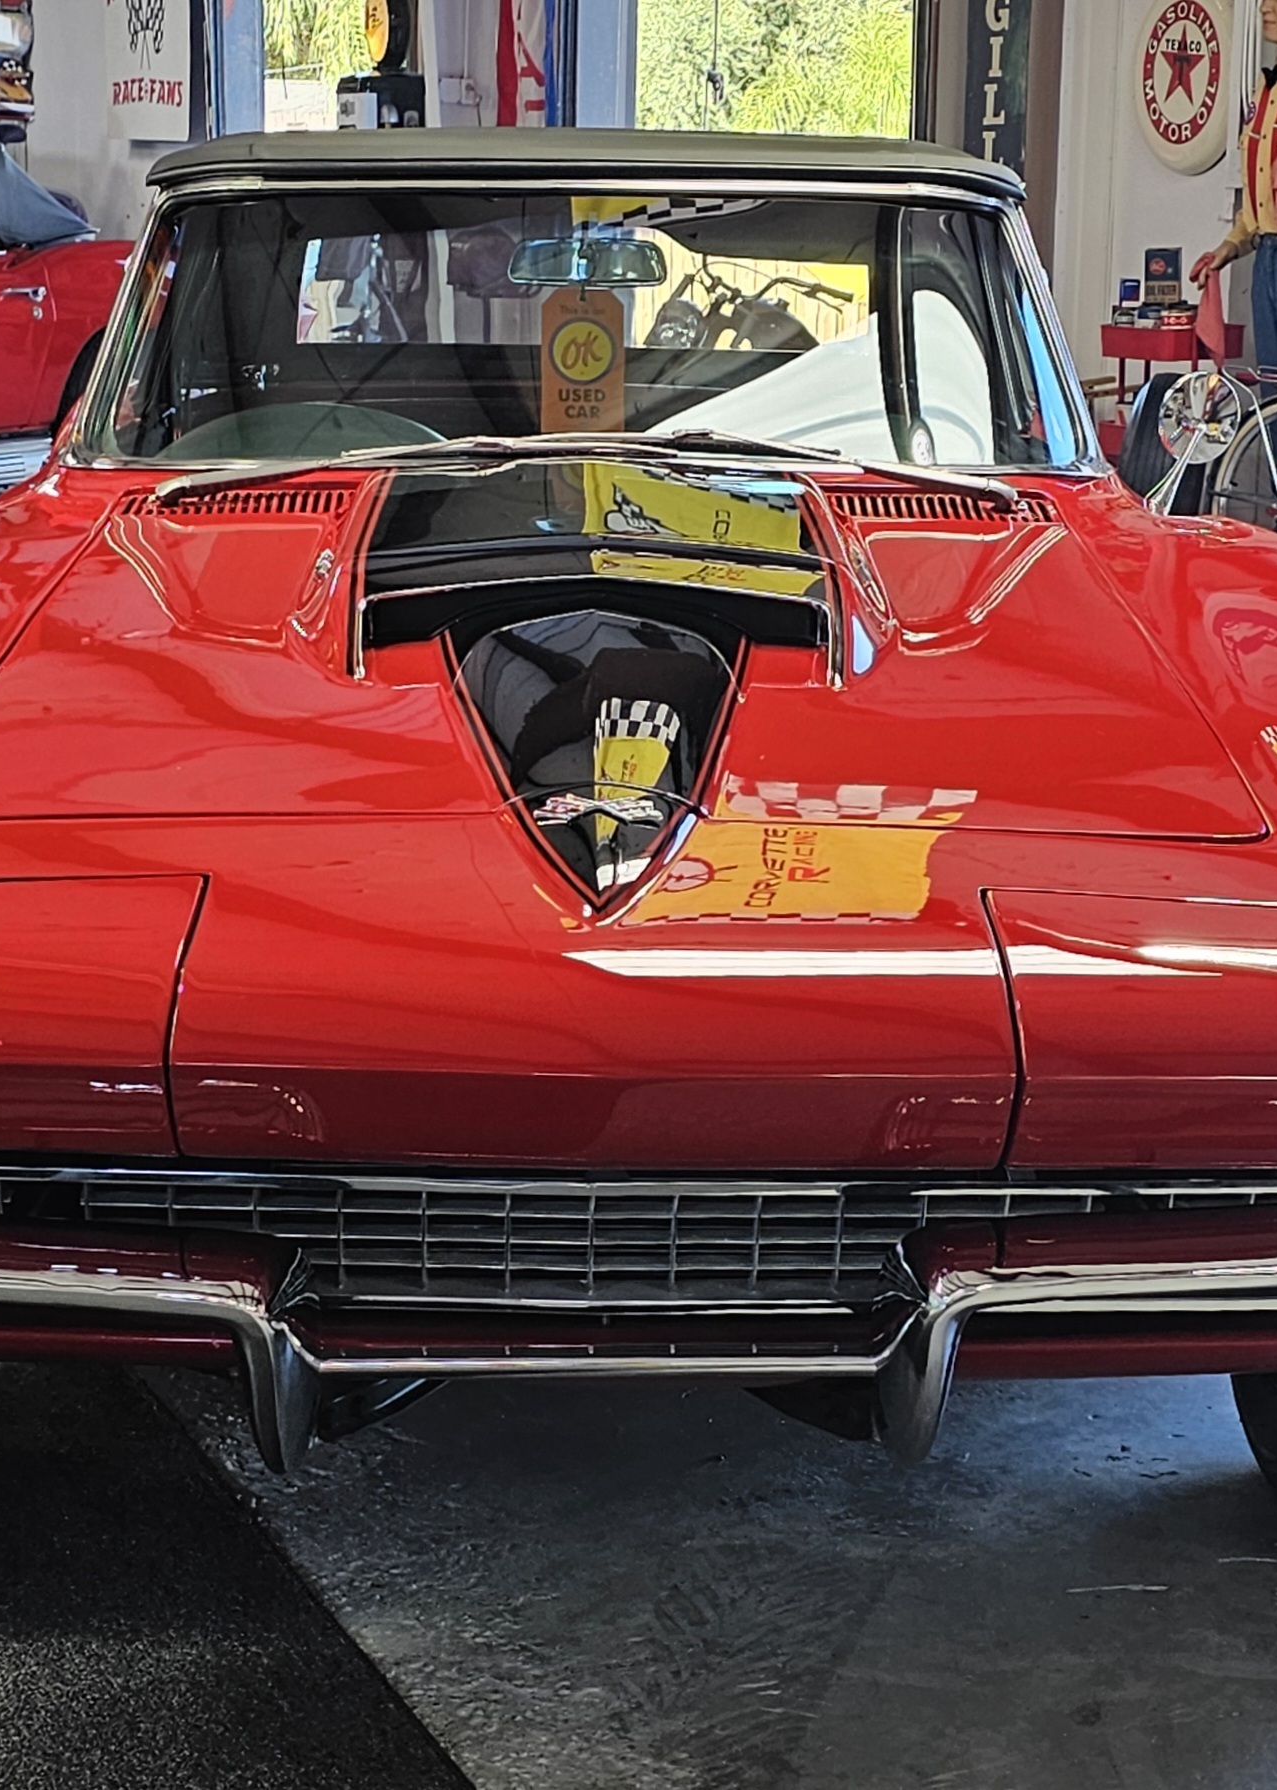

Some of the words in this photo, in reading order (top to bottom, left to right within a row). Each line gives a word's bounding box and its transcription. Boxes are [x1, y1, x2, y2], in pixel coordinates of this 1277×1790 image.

[1148, 1, 1218, 57] GASOLINE
[112, 77, 145, 106] RACE
[148, 78, 184, 108] FANS
[1144, 78, 1192, 142] MOTOR
[1196, 81, 1218, 125] OIL
[561, 330, 604, 370] OK
[558, 388, 606, 402] USED
[564, 405, 600, 419] CAR
